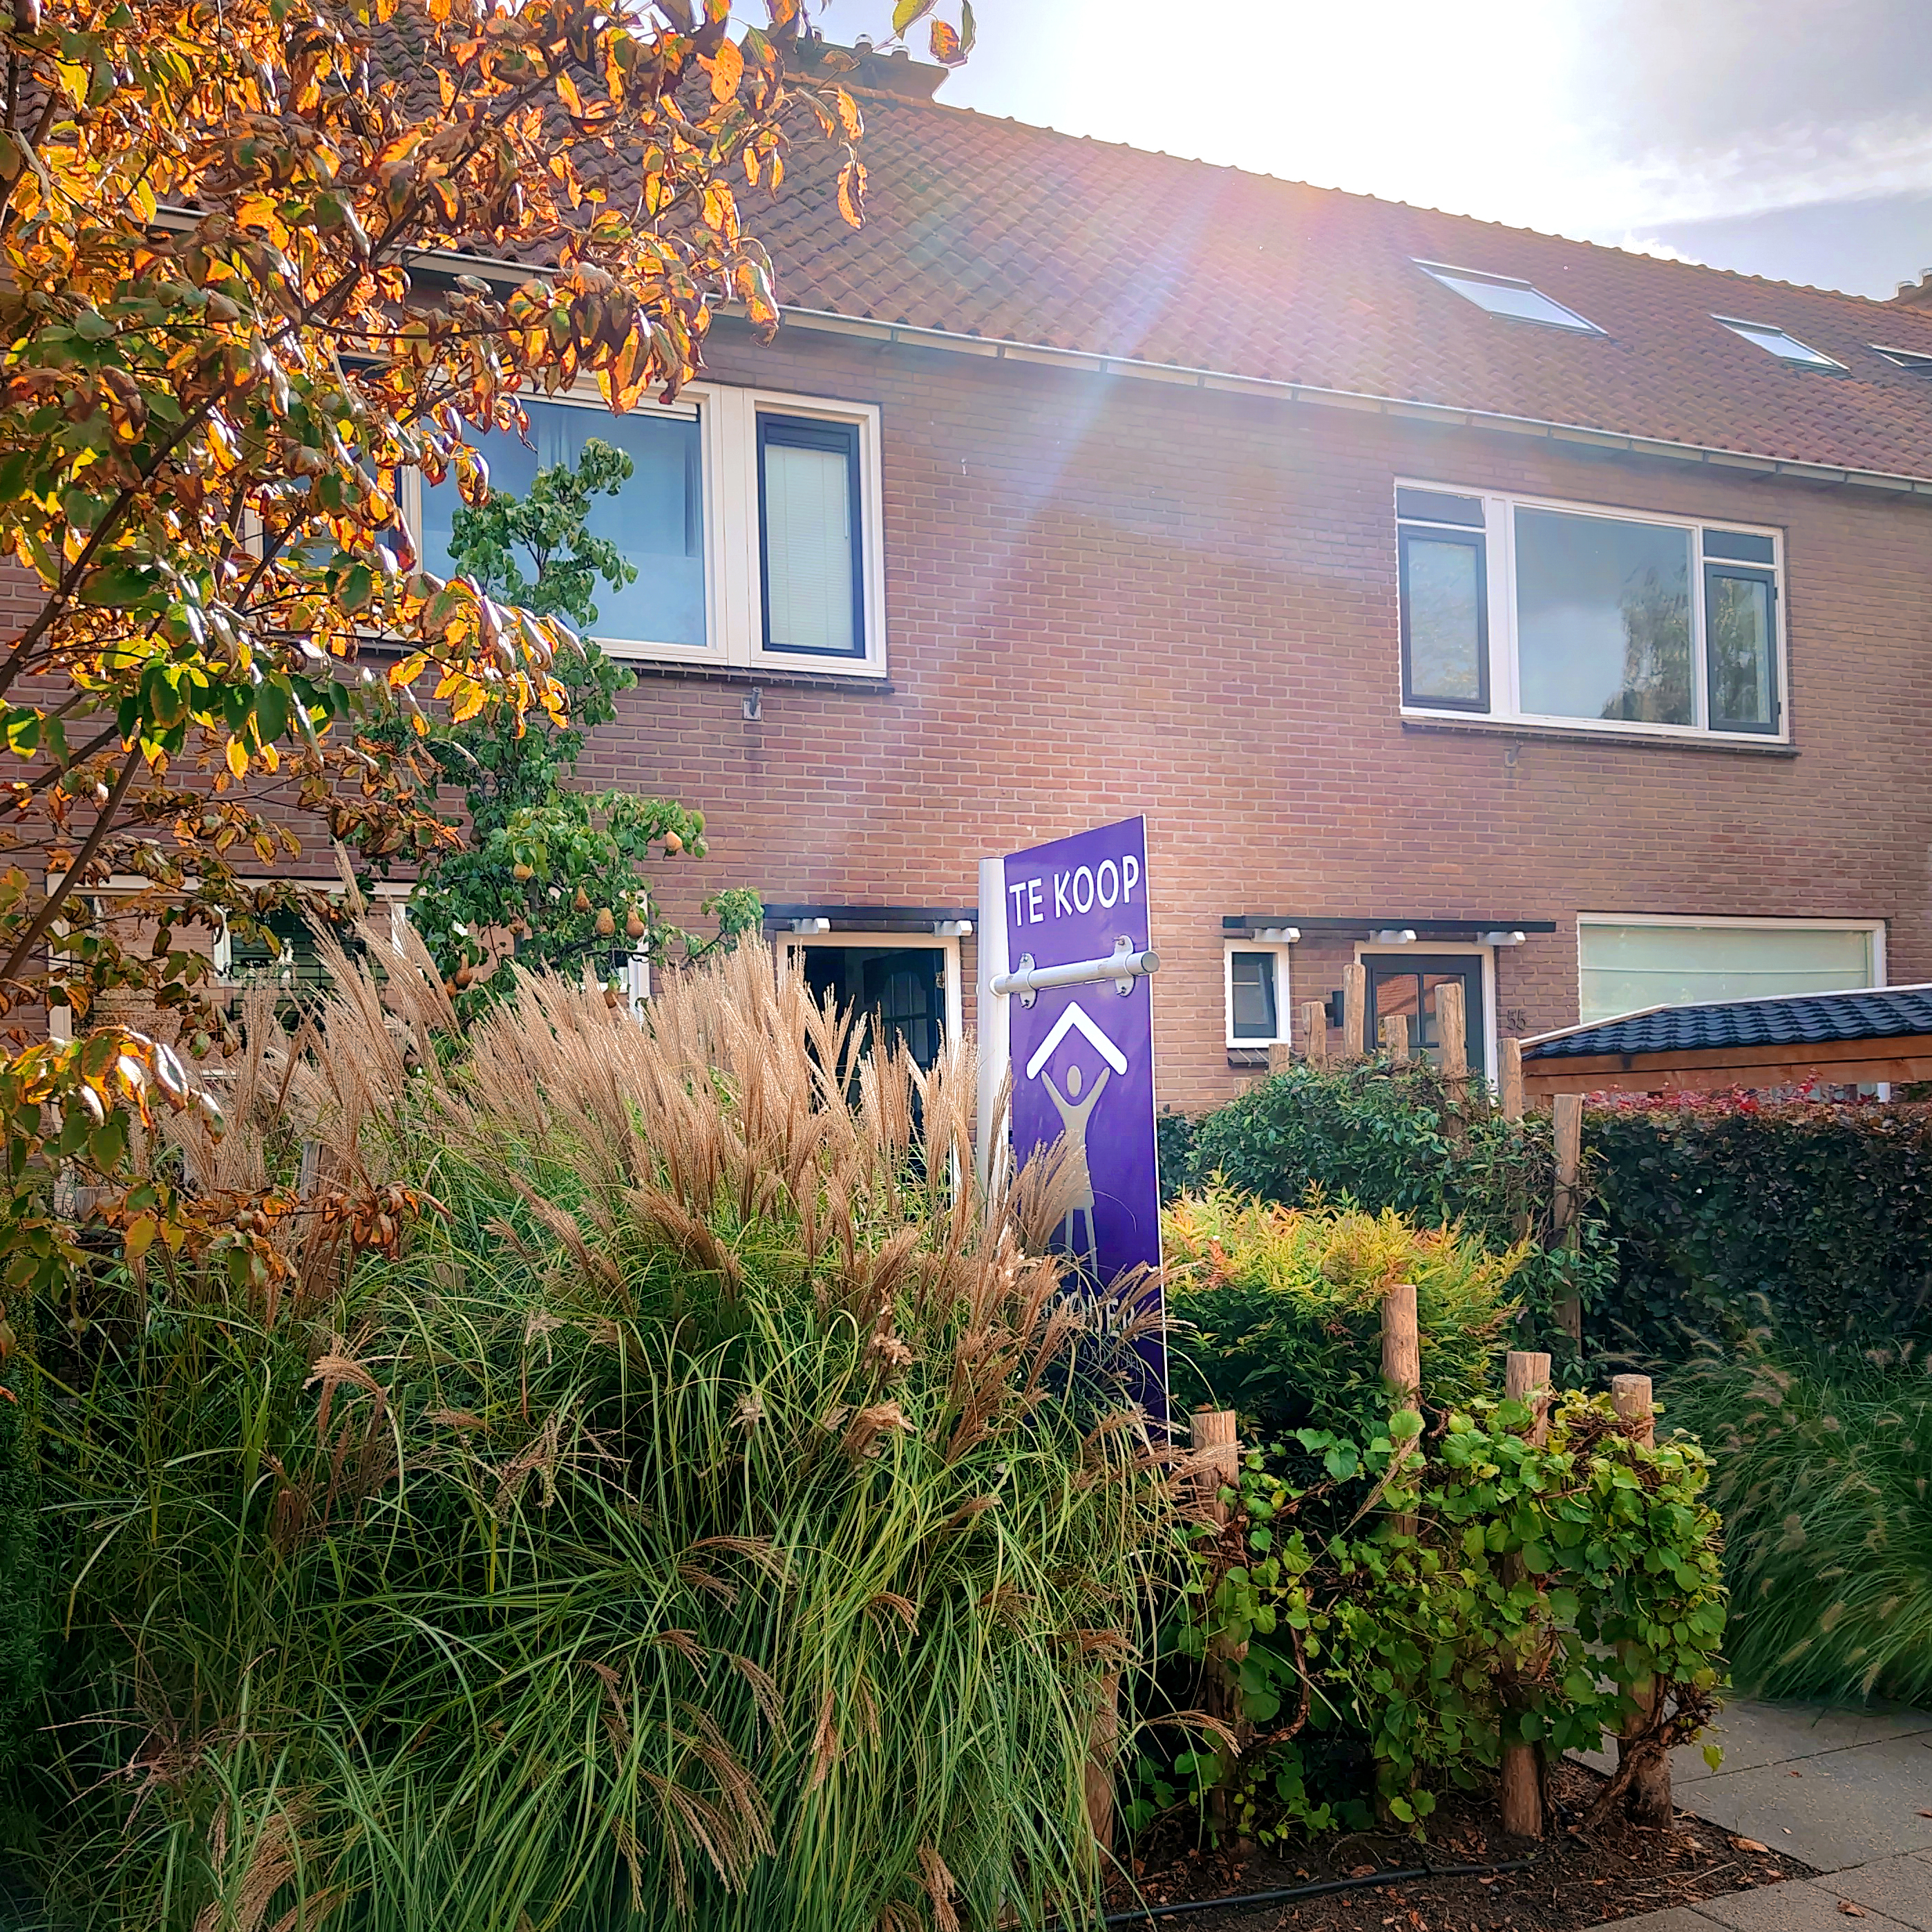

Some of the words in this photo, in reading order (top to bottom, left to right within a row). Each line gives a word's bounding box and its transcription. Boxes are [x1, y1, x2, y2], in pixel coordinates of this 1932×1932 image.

[1009, 878, 1044, 927] TE
[1054, 855, 1139, 918] KOOP
[1507, 1009, 1526, 1032] 55
